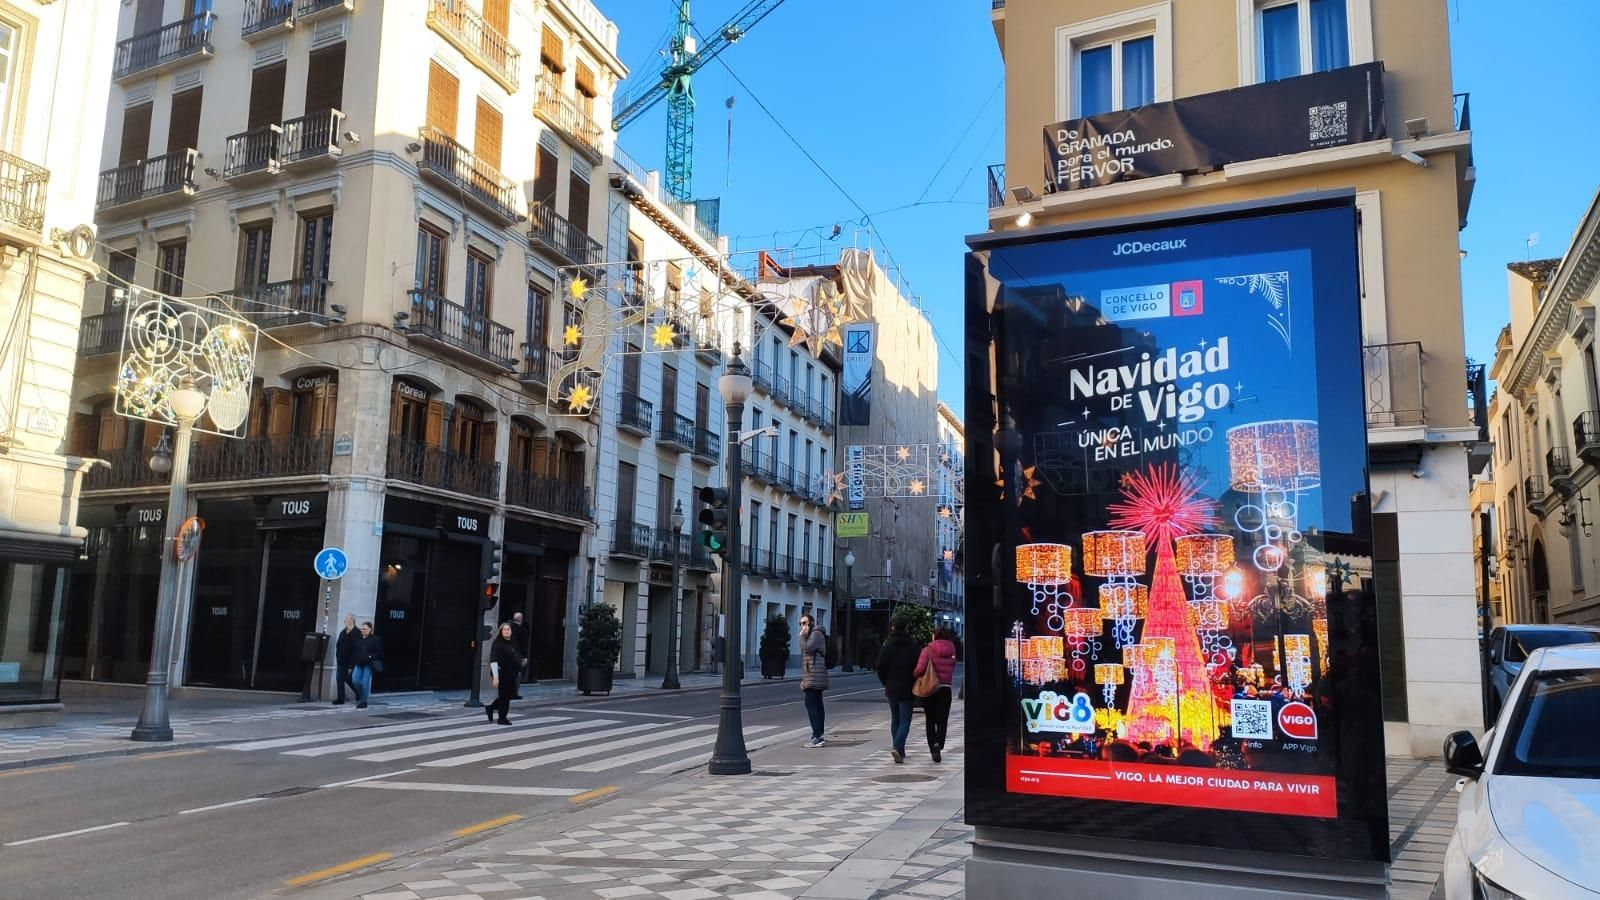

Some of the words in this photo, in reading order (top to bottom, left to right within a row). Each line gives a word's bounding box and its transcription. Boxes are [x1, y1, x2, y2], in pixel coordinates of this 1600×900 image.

[1057, 129, 1078, 141] De
[1057, 130, 1136, 155] GRANADA
[1057, 153, 1092, 171] para
[1097, 147, 1110, 160] el
[1115, 138, 1175, 156] mundo.
[1057, 157, 1134, 184] FERVOR
[1112, 239, 1188, 256] JCDecaux
[1105, 291, 1164, 305] CONCELLO
[1112, 305, 1126, 314] DE
[1130, 302, 1157, 312] VIGO
[1070, 337, 1229, 400] Navidad
[398, 381, 426, 399] Coreal
[1110, 393, 1133, 412] DE
[1138, 382, 1229, 422] Vigo
[1078, 425, 1133, 448] ÚNICA
[1094, 444, 1118, 462] EN
[1121, 441, 1140, 457] EL
[1143, 426, 1213, 451] MUNDO
[138, 508, 162, 522] TOUS
[281, 500, 310, 515] TOUS
[457, 516, 478, 531] TOUS
[212, 607, 227, 615] TOUS
[283, 609, 300, 619] TOUS
[390, 609, 405, 618] TOUS
[1282, 715, 1313, 725] VIGO
[1282, 743, 1298, 751] APP
[1300, 744, 1317, 753] Vigo
[1115, 771, 1146, 782] VIGO.
[1149, 773, 1162, 783] LA
[1166, 775, 1204, 786] MEJOR
[1207, 778, 1250, 790] CIUDAD
[1254, 781, 1283, 792] PARA
[1287, 783, 1320, 794] VIVIR
